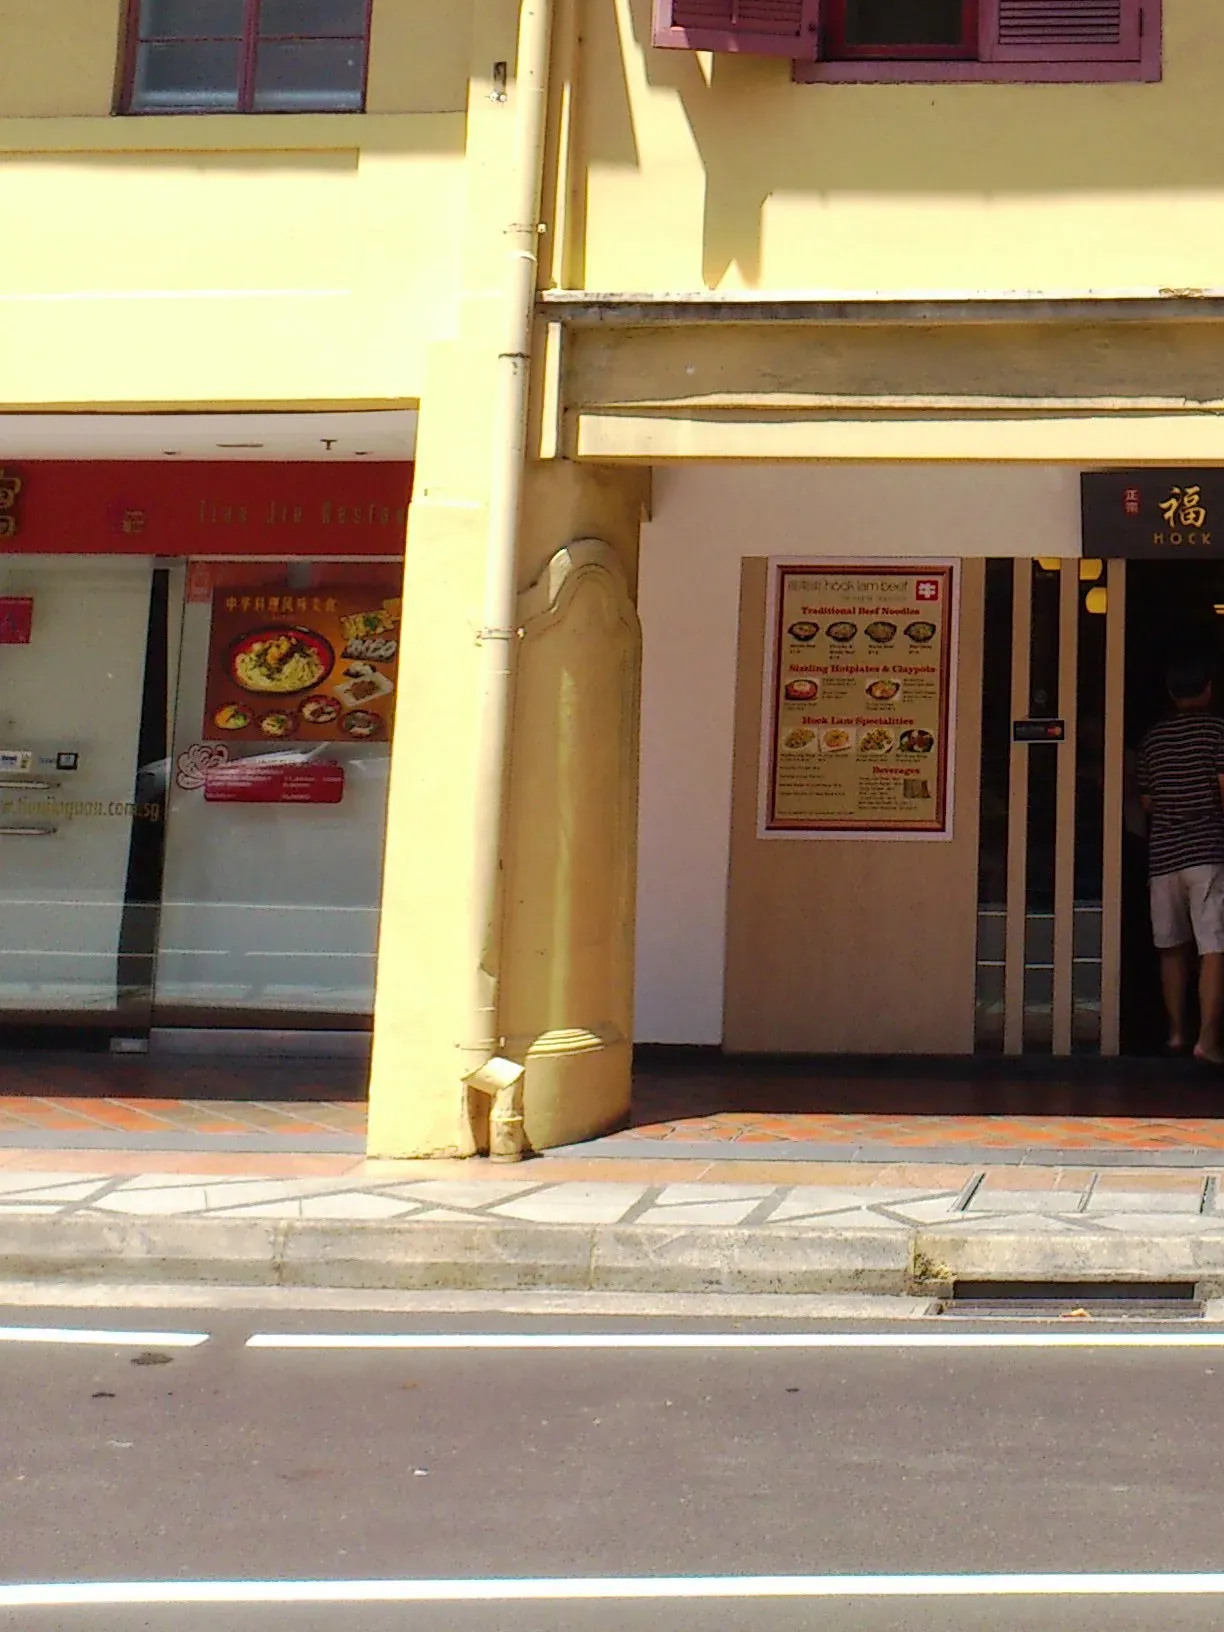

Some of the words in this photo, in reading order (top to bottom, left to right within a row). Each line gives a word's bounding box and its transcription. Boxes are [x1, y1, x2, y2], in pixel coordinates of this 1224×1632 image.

[1154, 532, 1212, 546] HOCK
[801, 606, 856, 615] Traditional
[858, 606, 880, 615] Beef
[881, 607, 920, 615] Noodles
[789, 664, 828, 674] Sizzling
[831, 664, 880, 674] Hotplates
[892, 664, 936, 674] Claypots
[802, 716, 828, 725] Hock
[831, 716, 853, 725] Lam
[872, 766, 920, 776] Beverages
